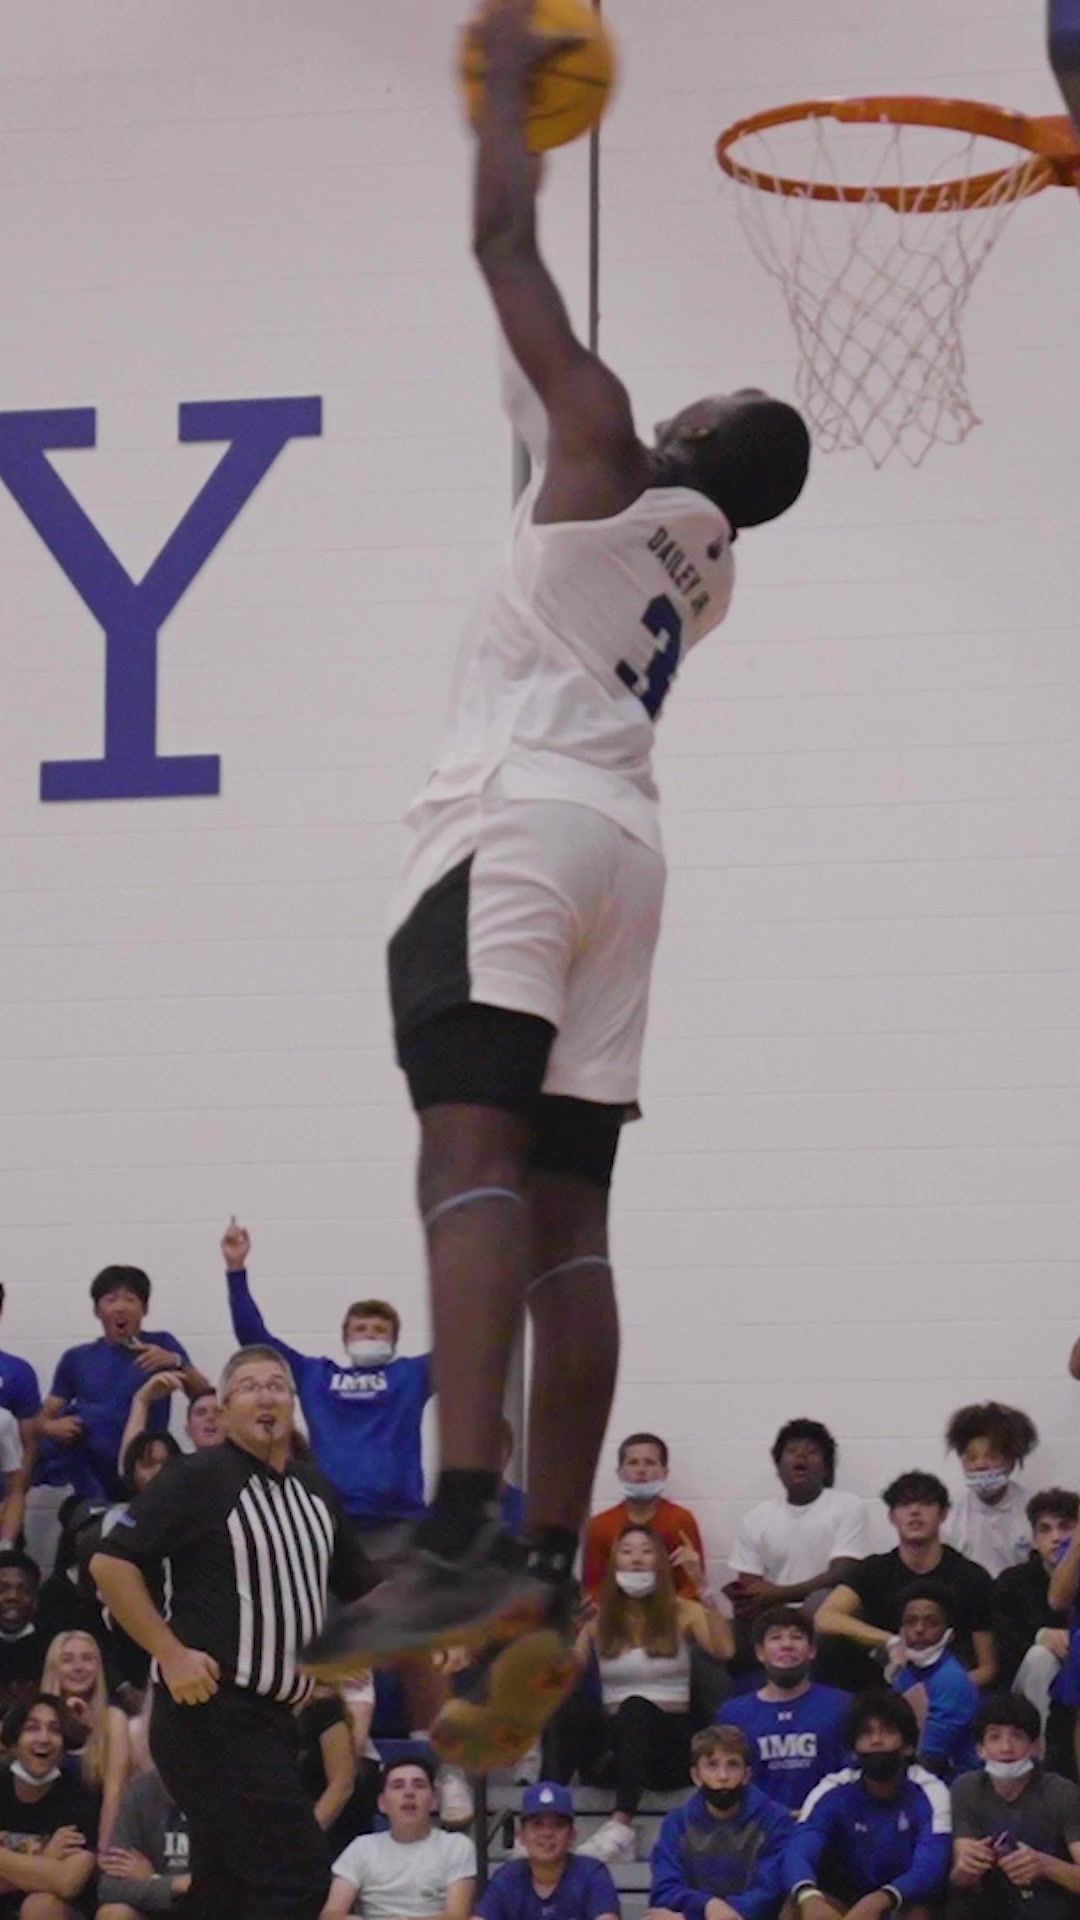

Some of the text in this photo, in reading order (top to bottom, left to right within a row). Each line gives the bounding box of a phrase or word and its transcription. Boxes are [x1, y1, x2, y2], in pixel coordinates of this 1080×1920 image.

[0, 396, 322, 802] Y
[615, 593, 682, 722] 3
[757, 1732, 818, 1760] IMG
